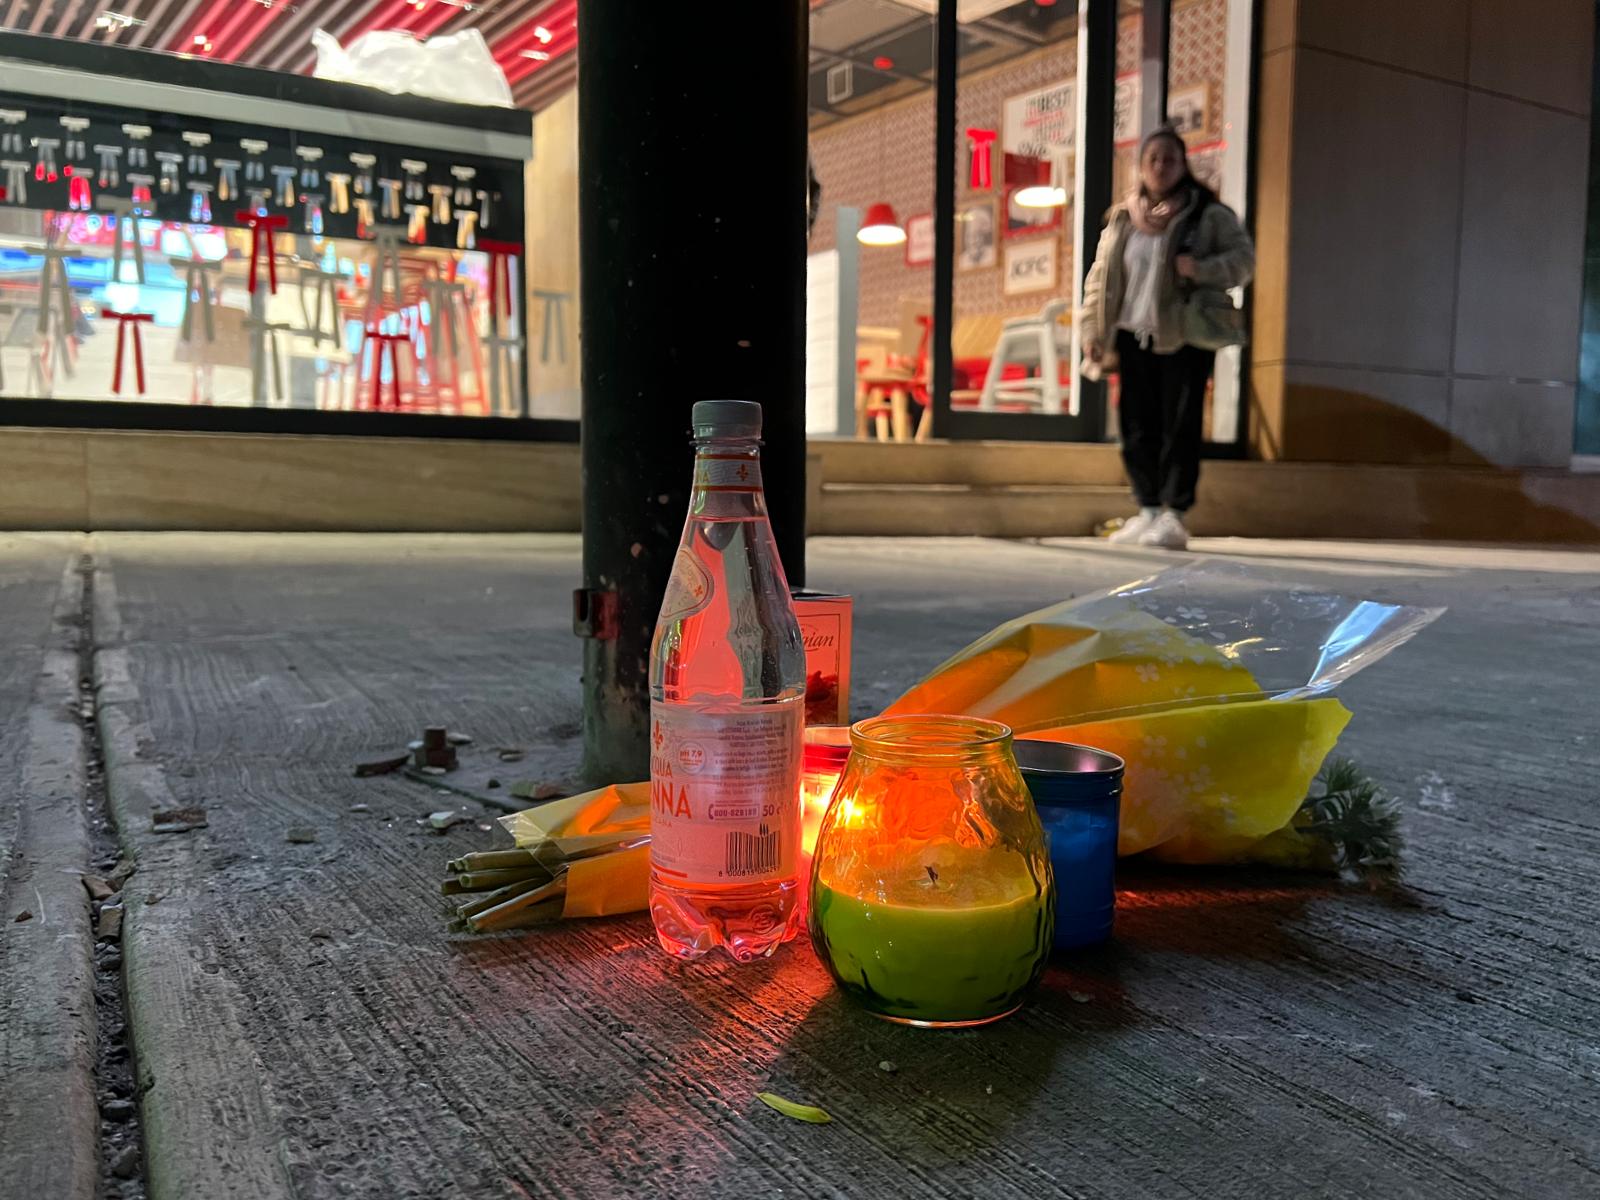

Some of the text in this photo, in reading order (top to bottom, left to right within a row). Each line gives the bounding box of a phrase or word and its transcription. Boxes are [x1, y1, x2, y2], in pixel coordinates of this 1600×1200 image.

[651, 755, 673, 778] QUA
[652, 779, 692, 819] NNA
[762, 803, 775, 817] 50
